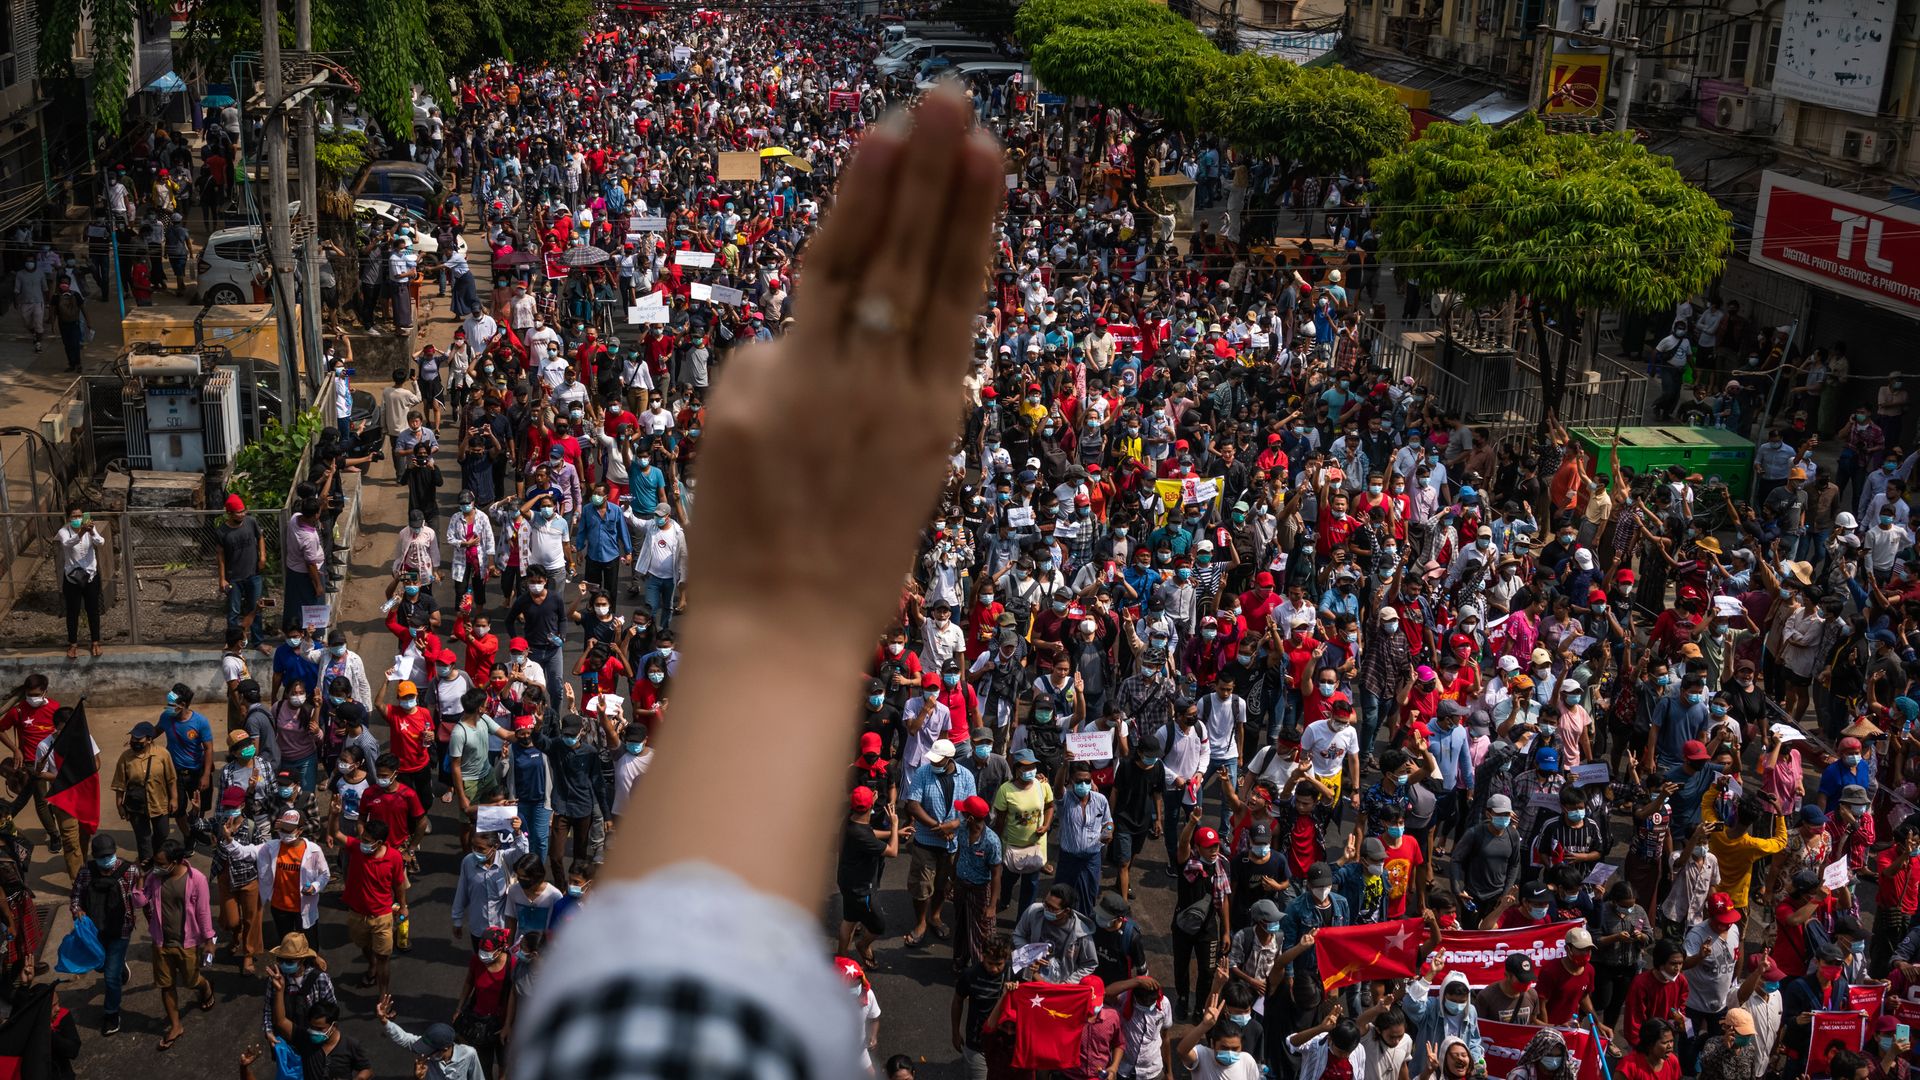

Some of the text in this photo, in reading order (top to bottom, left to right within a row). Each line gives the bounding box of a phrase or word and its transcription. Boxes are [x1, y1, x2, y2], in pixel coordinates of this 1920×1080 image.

[1831, 208, 1893, 274] TL
[1783, 247, 1920, 301] DIGITAL PHOTO SERVICE & PHOTO FR
